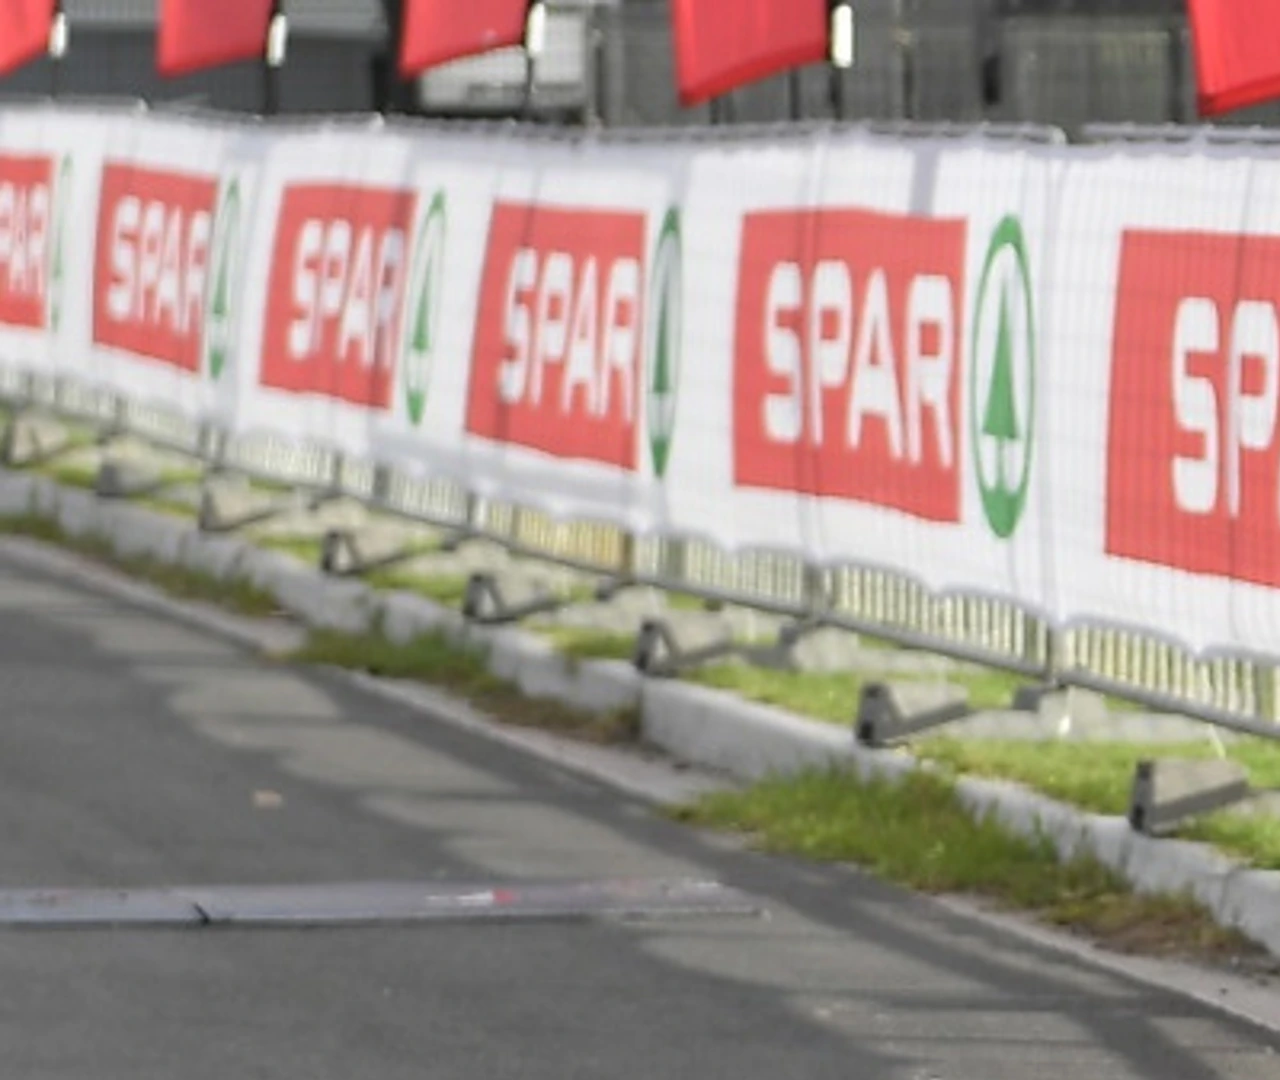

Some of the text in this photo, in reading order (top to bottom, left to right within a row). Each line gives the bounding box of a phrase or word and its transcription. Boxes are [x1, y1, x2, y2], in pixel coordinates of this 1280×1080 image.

[0, 181, 48, 297] PAR
[107, 195, 212, 335] SPAR
[288, 218, 403, 370] SPAR
[497, 247, 640, 424] SPAR
[764, 260, 954, 469] SPAR
